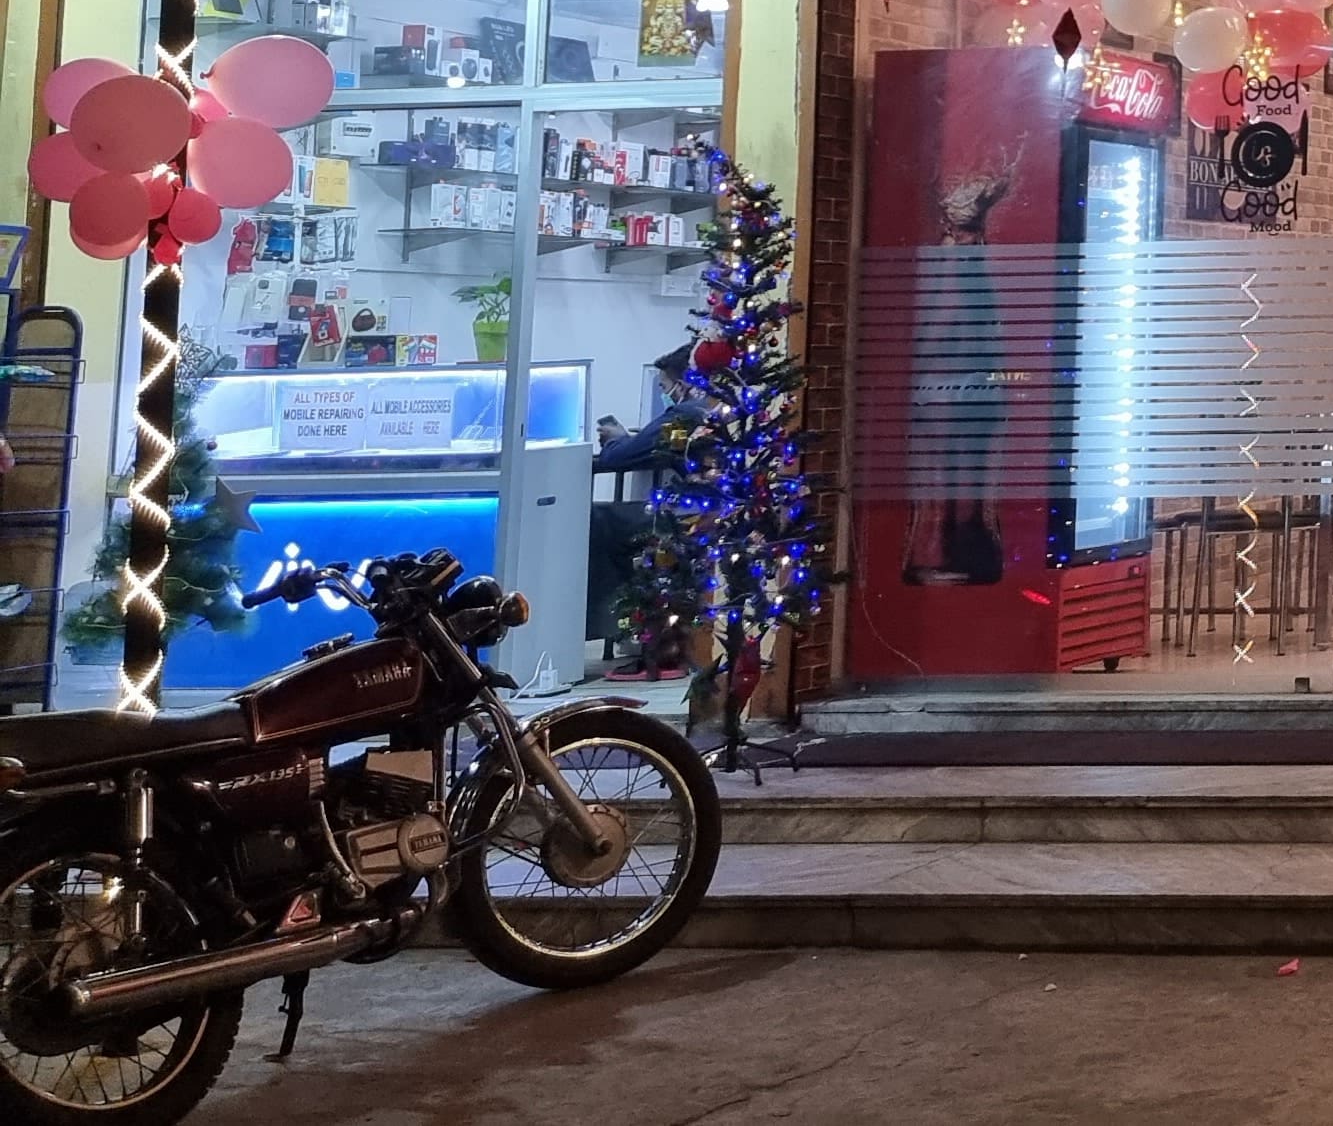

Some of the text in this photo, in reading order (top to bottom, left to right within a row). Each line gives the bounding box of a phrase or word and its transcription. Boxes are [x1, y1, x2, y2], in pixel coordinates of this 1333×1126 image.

[1222, 64, 1301, 107] Good
[1256, 104, 1292, 116] Food
[1190, 160, 1219, 183] BON
[1220, 179, 1298, 224] Good
[1249, 221, 1292, 236] Mood
[294, 391, 355, 404] ALL TYPES OF
[283, 408, 364, 420] MOBILE REPAIRING
[297, 424, 348, 437] DONE HERE
